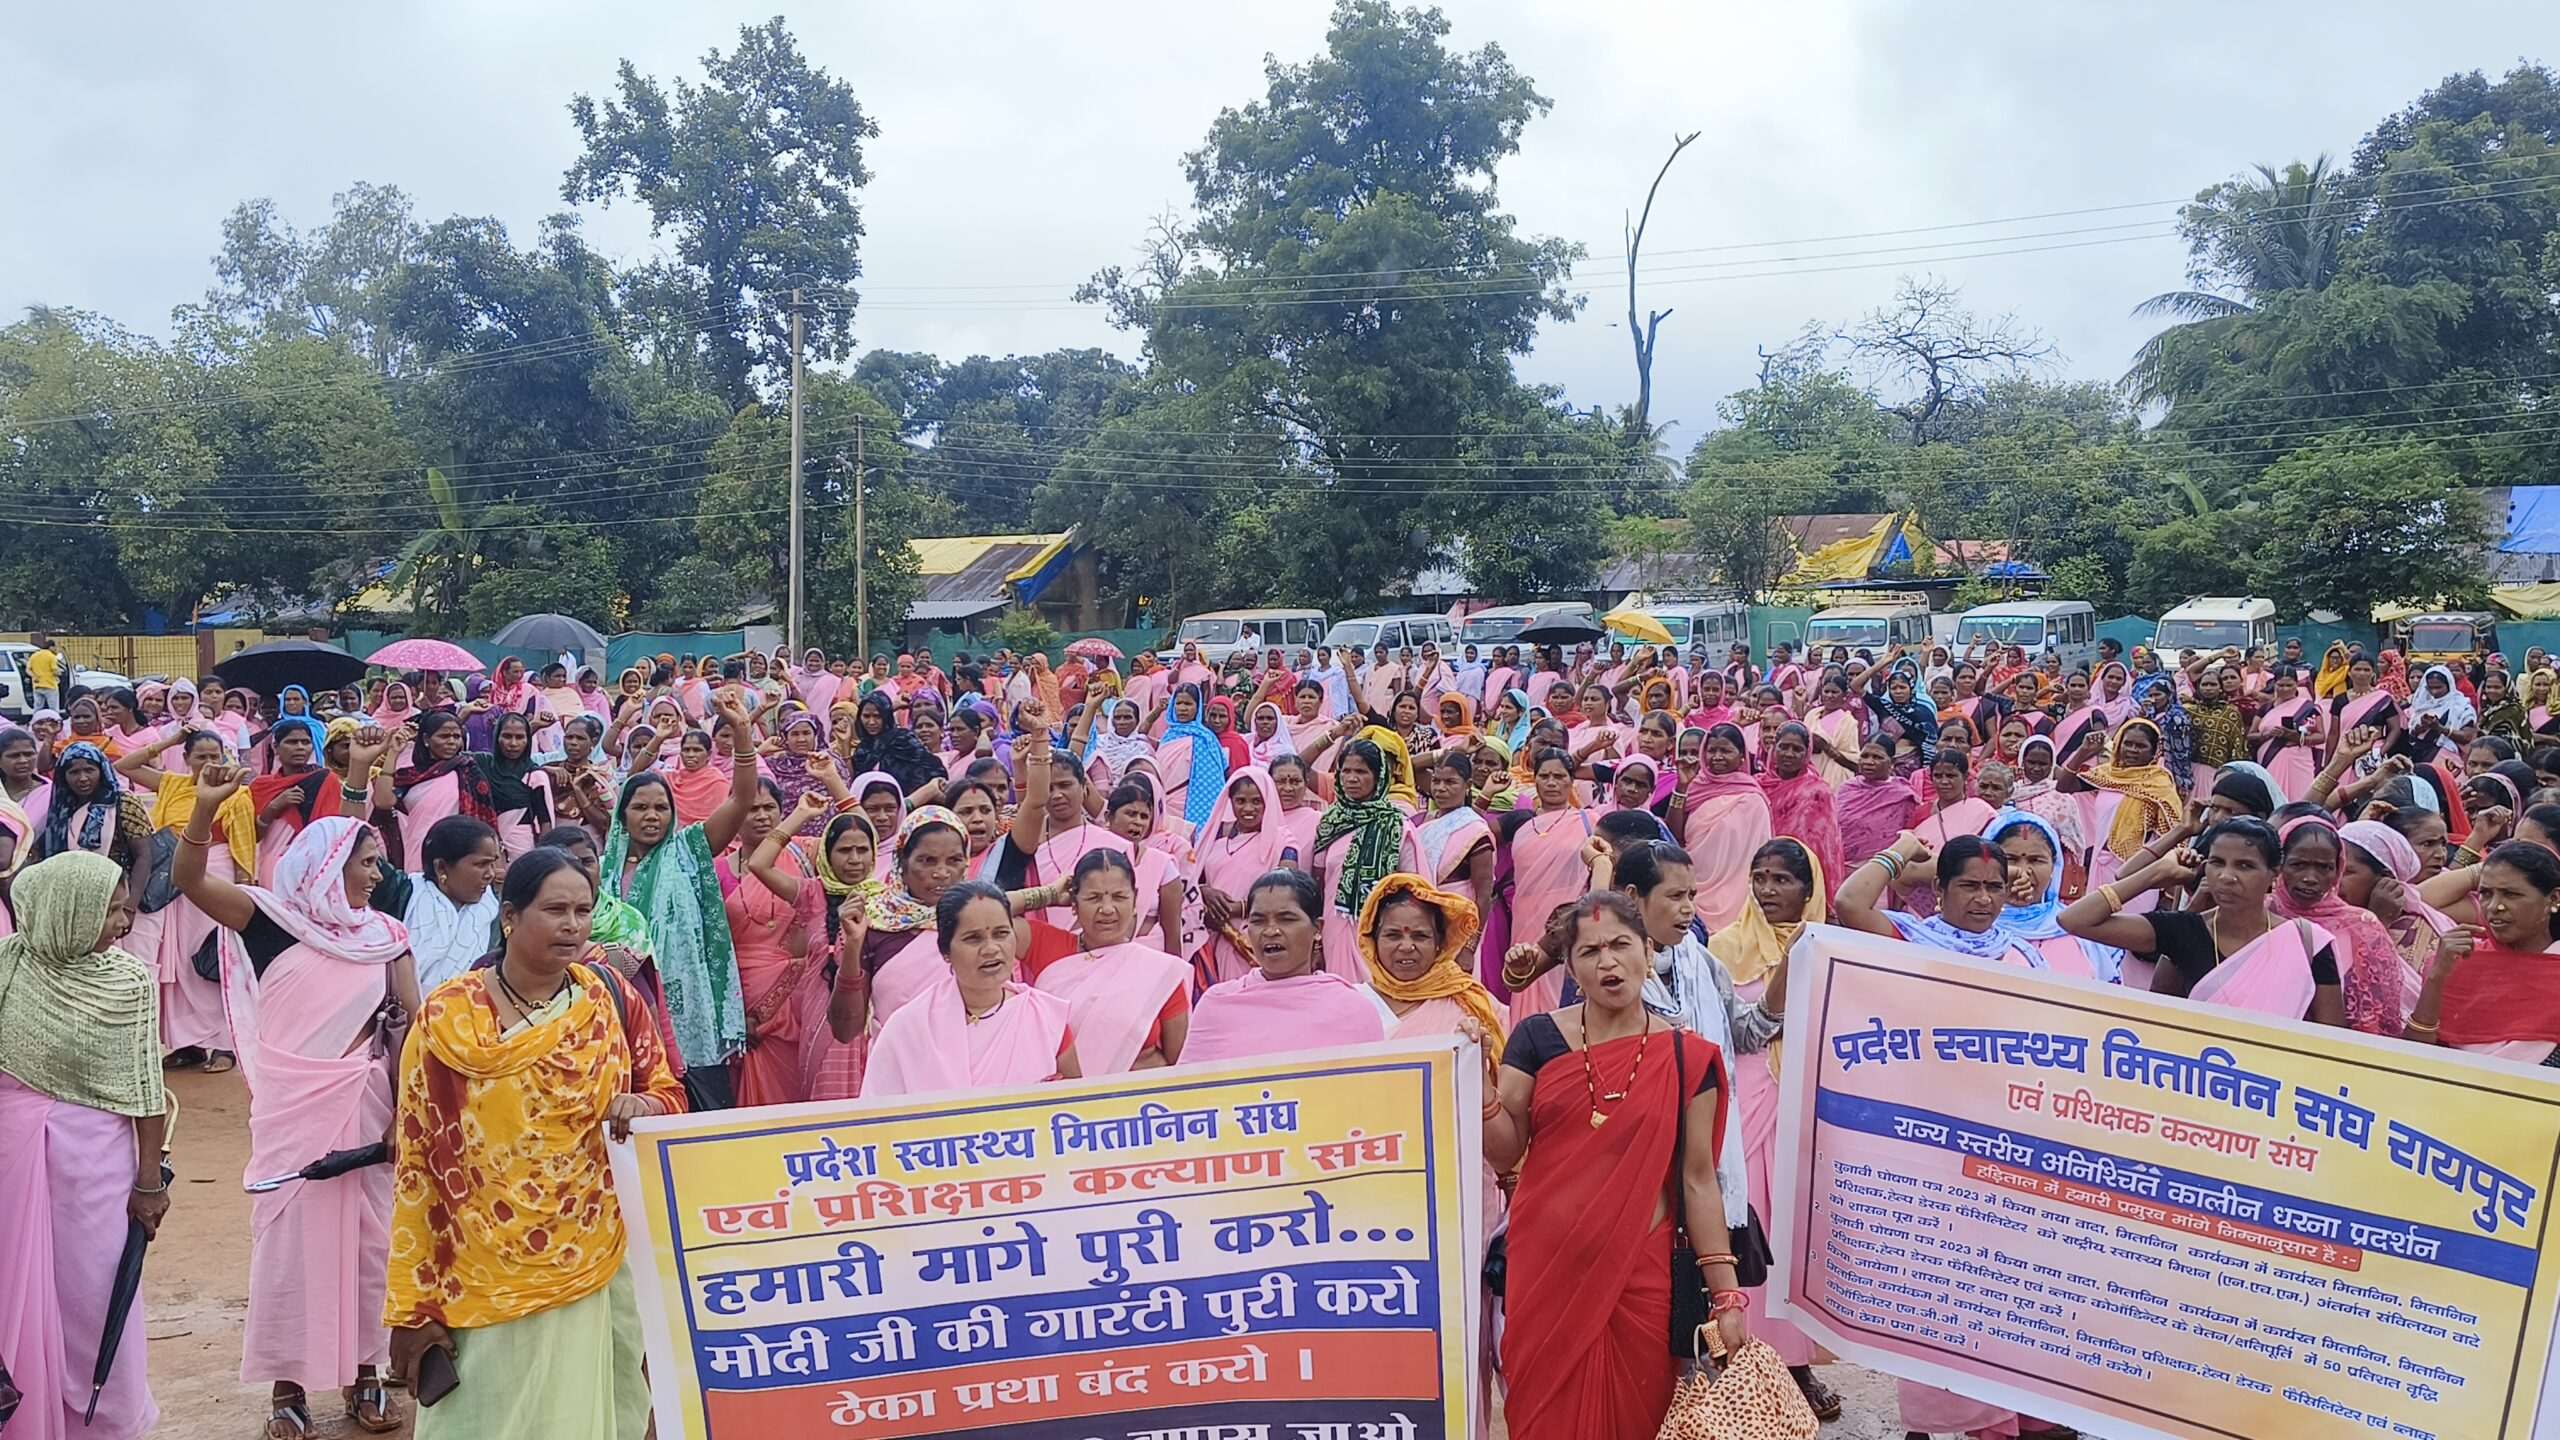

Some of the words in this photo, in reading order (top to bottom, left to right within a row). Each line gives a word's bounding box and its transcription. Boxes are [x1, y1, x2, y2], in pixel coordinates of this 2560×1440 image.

[784, 1137, 877, 1186] प्रदेश
[893, 1128, 1036, 1171] स्वास्थ्य
[1051, 1103, 1218, 1154] मितानिन
[1234, 1091, 1298, 1134] संघ
[1832, 1018, 1920, 1071] प्रदेश
[1932, 1028, 2088, 1072] स्वास्थ्य
[2102, 1029, 2281, 1117] मितानिन
[2294, 1086, 2375, 1150] संघ
[2388, 1119, 2536, 1233] रायपुर
[2008, 1081, 2044, 1113] एवं
[2053, 1089, 2155, 1134] प्रशिक्षक
[2161, 1117, 2260, 1160] कल्याण
[2268, 1135, 2318, 1172] संघ
[703, 1190, 789, 1234] एवं
[814, 1181, 1046, 1227] प्रशिक्षक
[1070, 1149, 1285, 1195] कल्याण
[1309, 1130, 1402, 1171] संघ
[1829, 1193, 1844, 1207] को
[1848, 1200, 1887, 1218] शासन
[1892, 1210, 1913, 1225] पूरा
[1918, 1215, 1940, 1231] करें
[1894, 1116, 1949, 1145] राज्य
[1957, 1130, 2034, 1166] स्तरीय
[2168, 1185, 2263, 1221] कालीन
[2273, 1205, 2342, 1239] धरना
[2350, 1224, 2441, 1260] प्रदर्शन
[2044, 1179, 2059, 1194] में
[2065, 1191, 2112, 1208] हमारी
[2117, 1201, 2166, 1221] प्रमुख
[2172, 1212, 2211, 1231] मांगे
[2217, 1220, 2317, 1256] निम्नानुसार
[2322, 1243, 2336, 1263] है
[697, 1241, 884, 1314] हमारी
[913, 1221, 1047, 1285] मांगे
[1076, 1208, 1182, 1286] पुरी
[1827, 1240, 1850, 1261] किया
[1855, 1256, 1899, 1276] जायेगा
[1911, 1269, 1951, 1288] शासन
[1955, 1278, 1976, 1294] यह
[1979, 1287, 2008, 1303] वादा
[2013, 1296, 2035, 1313] पूरा
[2039, 1303, 2063, 1319] करें
[1833, 1160, 1872, 1177] चुनावी
[1877, 1168, 1918, 1188] घोषणा
[1922, 1179, 1943, 1193] पत्र
[1947, 1185, 1979, 1201] 2023
[1984, 1192, 1997, 1206] में
[2002, 1198, 2036, 1217] किया
[2041, 1208, 2070, 1225] गया
[2115, 1226, 2178, 1252] मितानिन
[2254, 1260, 2268, 1274] में
[2410, 1296, 2478, 1326] मितानिन
[1918, 1194, 1951, 1213] डेस्क
[2037, 1227, 2056, 1241] को
[2110, 1246, 2163, 1268] स्वास्थ्य
[2168, 1258, 2211, 1280] मिशन
[2316, 1296, 2371, 1320] अंतर्गत
[2376, 1309, 2447, 1340] संविलयन
[2452, 1330, 2481, 1350] वादे
[704, 1326, 830, 1379] मोदी
[846, 1316, 917, 1363] जी
[933, 1304, 1009, 1352] की
[1025, 1286, 1187, 1341] गारंटी
[1204, 1271, 1297, 1334] पुरी
[1314, 1266, 1419, 1316] करो
[1826, 1258, 1873, 1288] मितानिन
[1936, 1291, 1949, 1305] में
[2076, 1329, 2136, 1356] मितानिन
[2236, 1373, 2272, 1393] डेस्क
[2367, 1415, 2388, 1429] एवं
[1830, 1211, 1865, 1231] चुनावी
[1869, 1220, 1910, 1241] घोषणा
[1915, 1232, 1935, 1246] पत्र
[1940, 1239, 1971, 1255] 2023
[1976, 1246, 1989, 1259] में
[1994, 1251, 2028, 1271] किया
[2033, 1263, 2062, 1280] गया
[2107, 1281, 2169, 1307] मितानिन
[2245, 1316, 2258, 1330] में
[2399, 1356, 2465, 1387] मितानिन
[1910, 1248, 1944, 1266] डेस्क
[2024, 1278, 2044, 1293] एवं
[2172, 1318, 2188, 1332] के
[2304, 1352, 2318, 1366] में
[2323, 1360, 2341, 1373] 50
[2347, 1366, 2401, 1390] प्रतिशत
[2406, 1382, 2439, 1403] वृद्धि
[826, 1389, 936, 1426] ठेका
[953, 1375, 1059, 1412] प्रथा
[1076, 1360, 1150, 1395] बंद
[1166, 1345, 1268, 1386] करो
